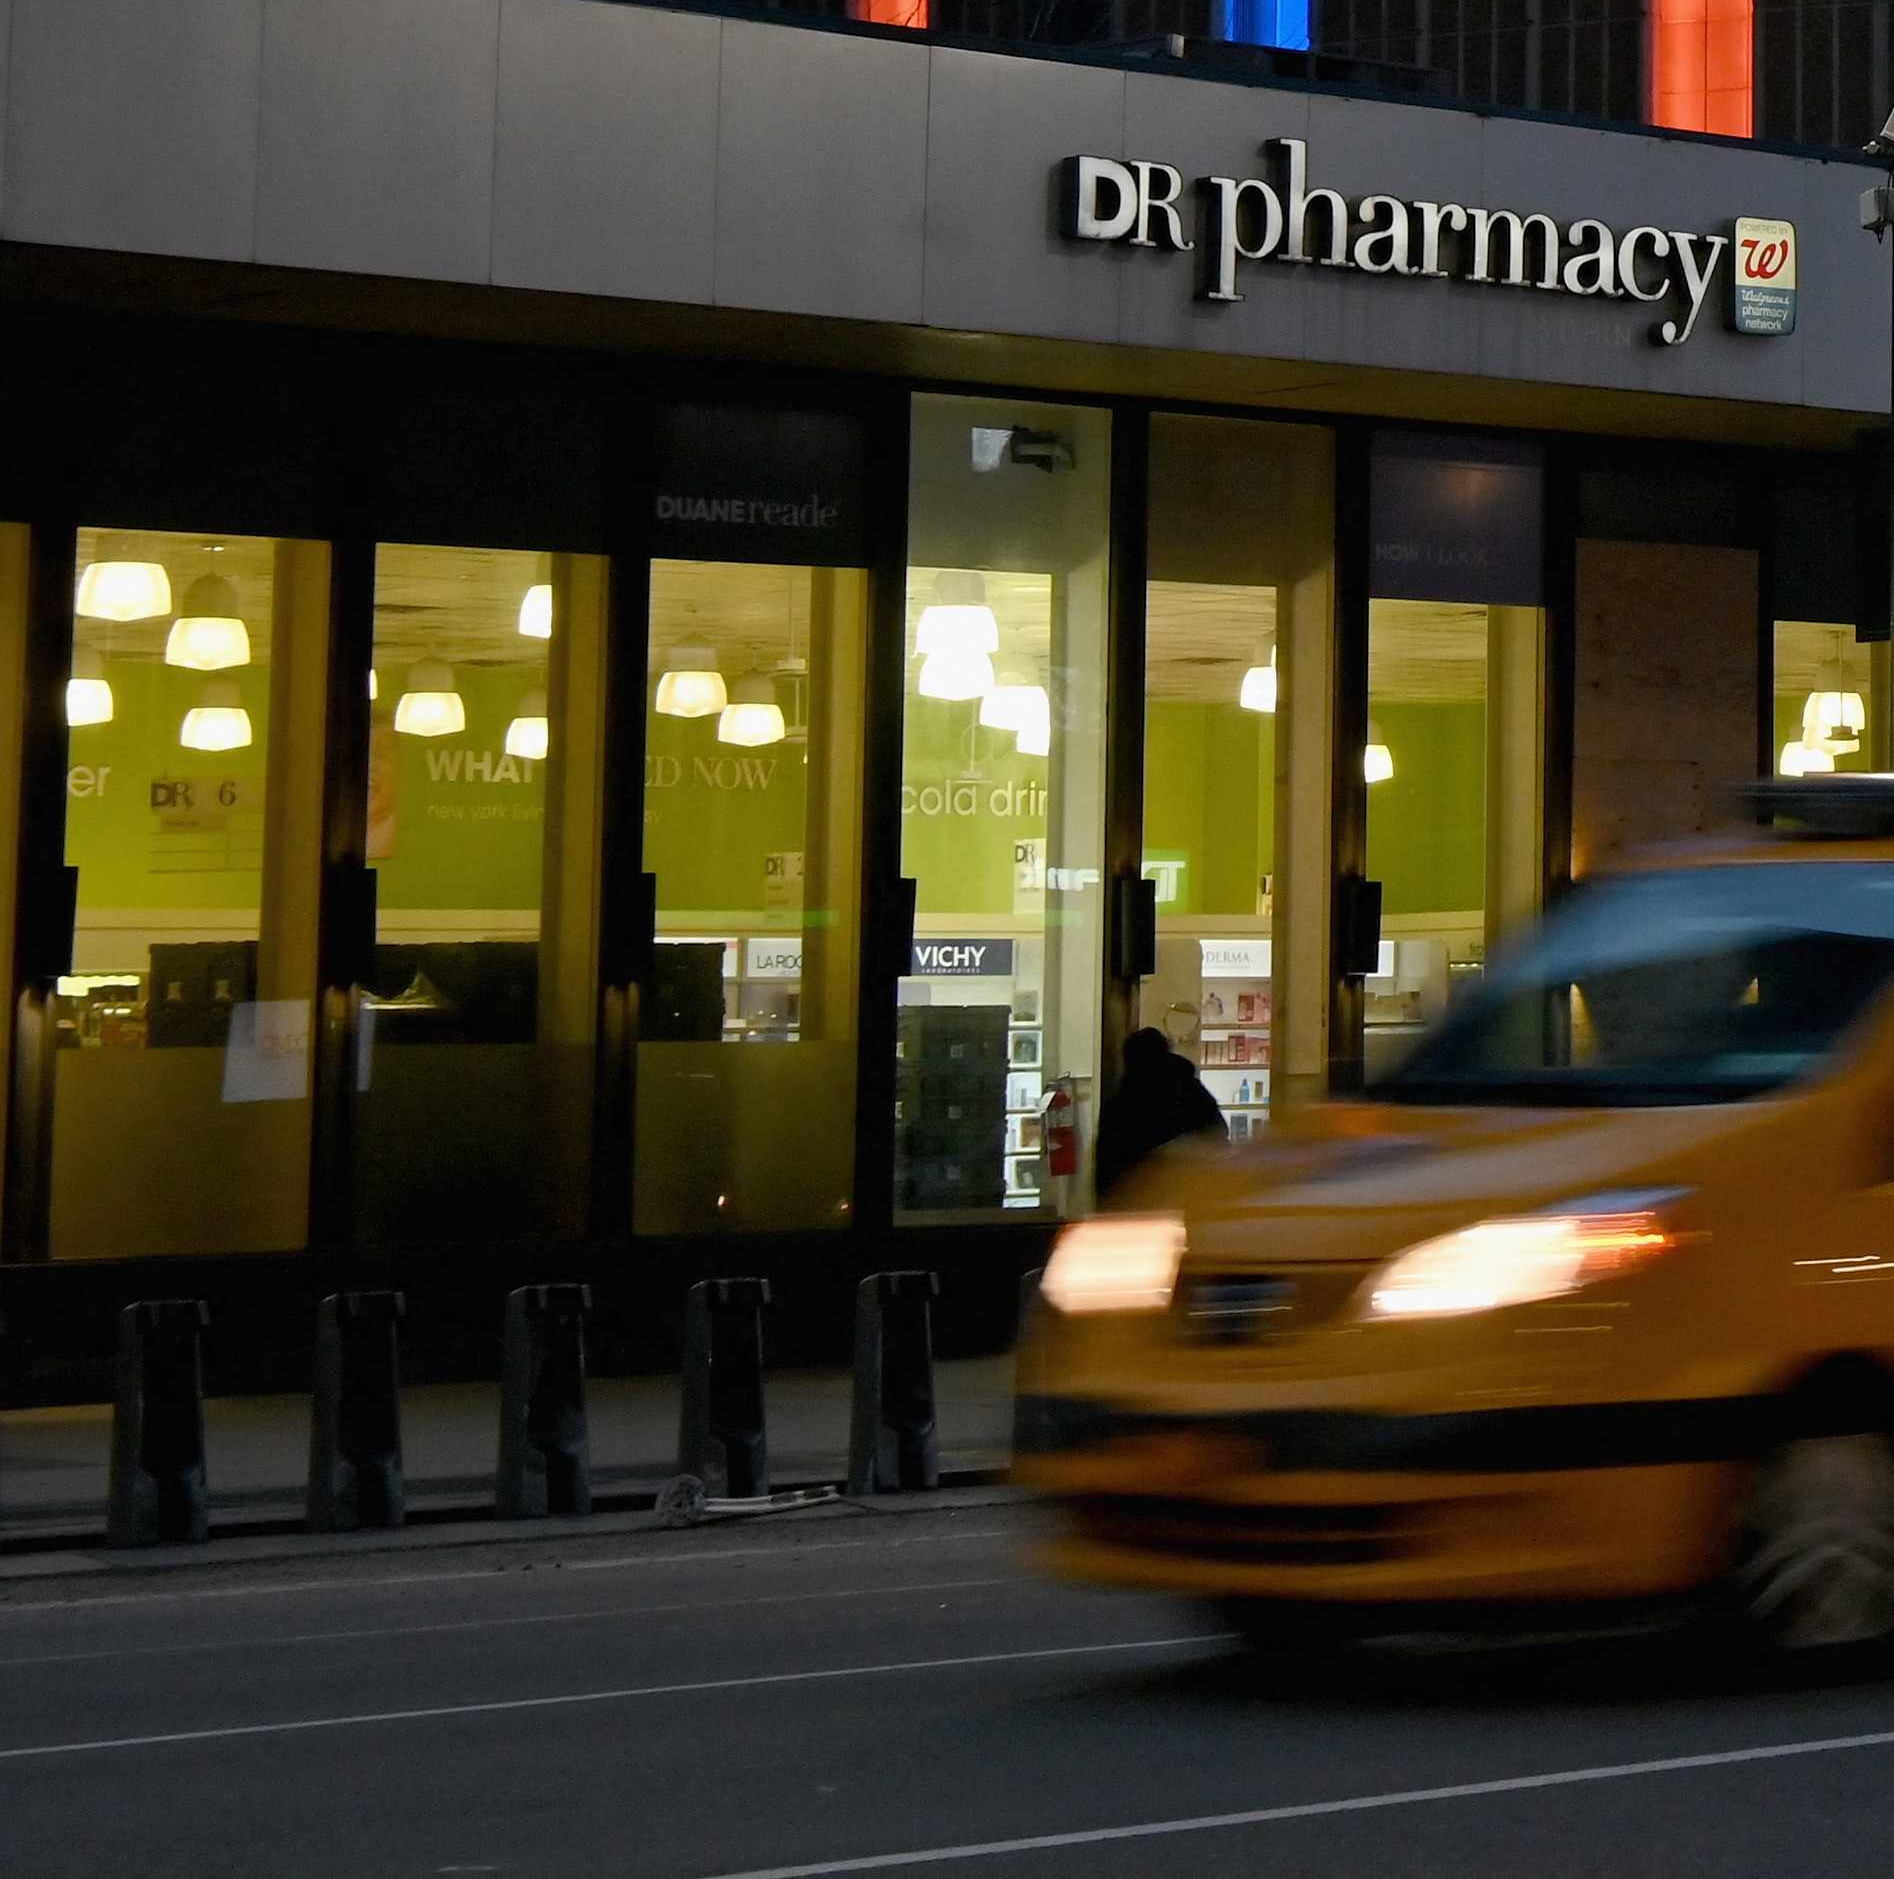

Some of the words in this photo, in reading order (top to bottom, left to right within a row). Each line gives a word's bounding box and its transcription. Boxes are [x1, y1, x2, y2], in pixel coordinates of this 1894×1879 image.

[1077, 155, 1196, 252] DR
[1208, 138, 1730, 345] pharmacy
[1742, 305, 1788, 321] pharmacy
[1745, 320, 1782, 330] network
[693, 757, 777, 791] NOW
[151, 779, 194, 809] DR
[219, 780, 236, 806] 6
[903, 780, 976, 815] cold
[915, 945, 987, 968] VICHY
[1202, 951, 1250, 963] DERMA
